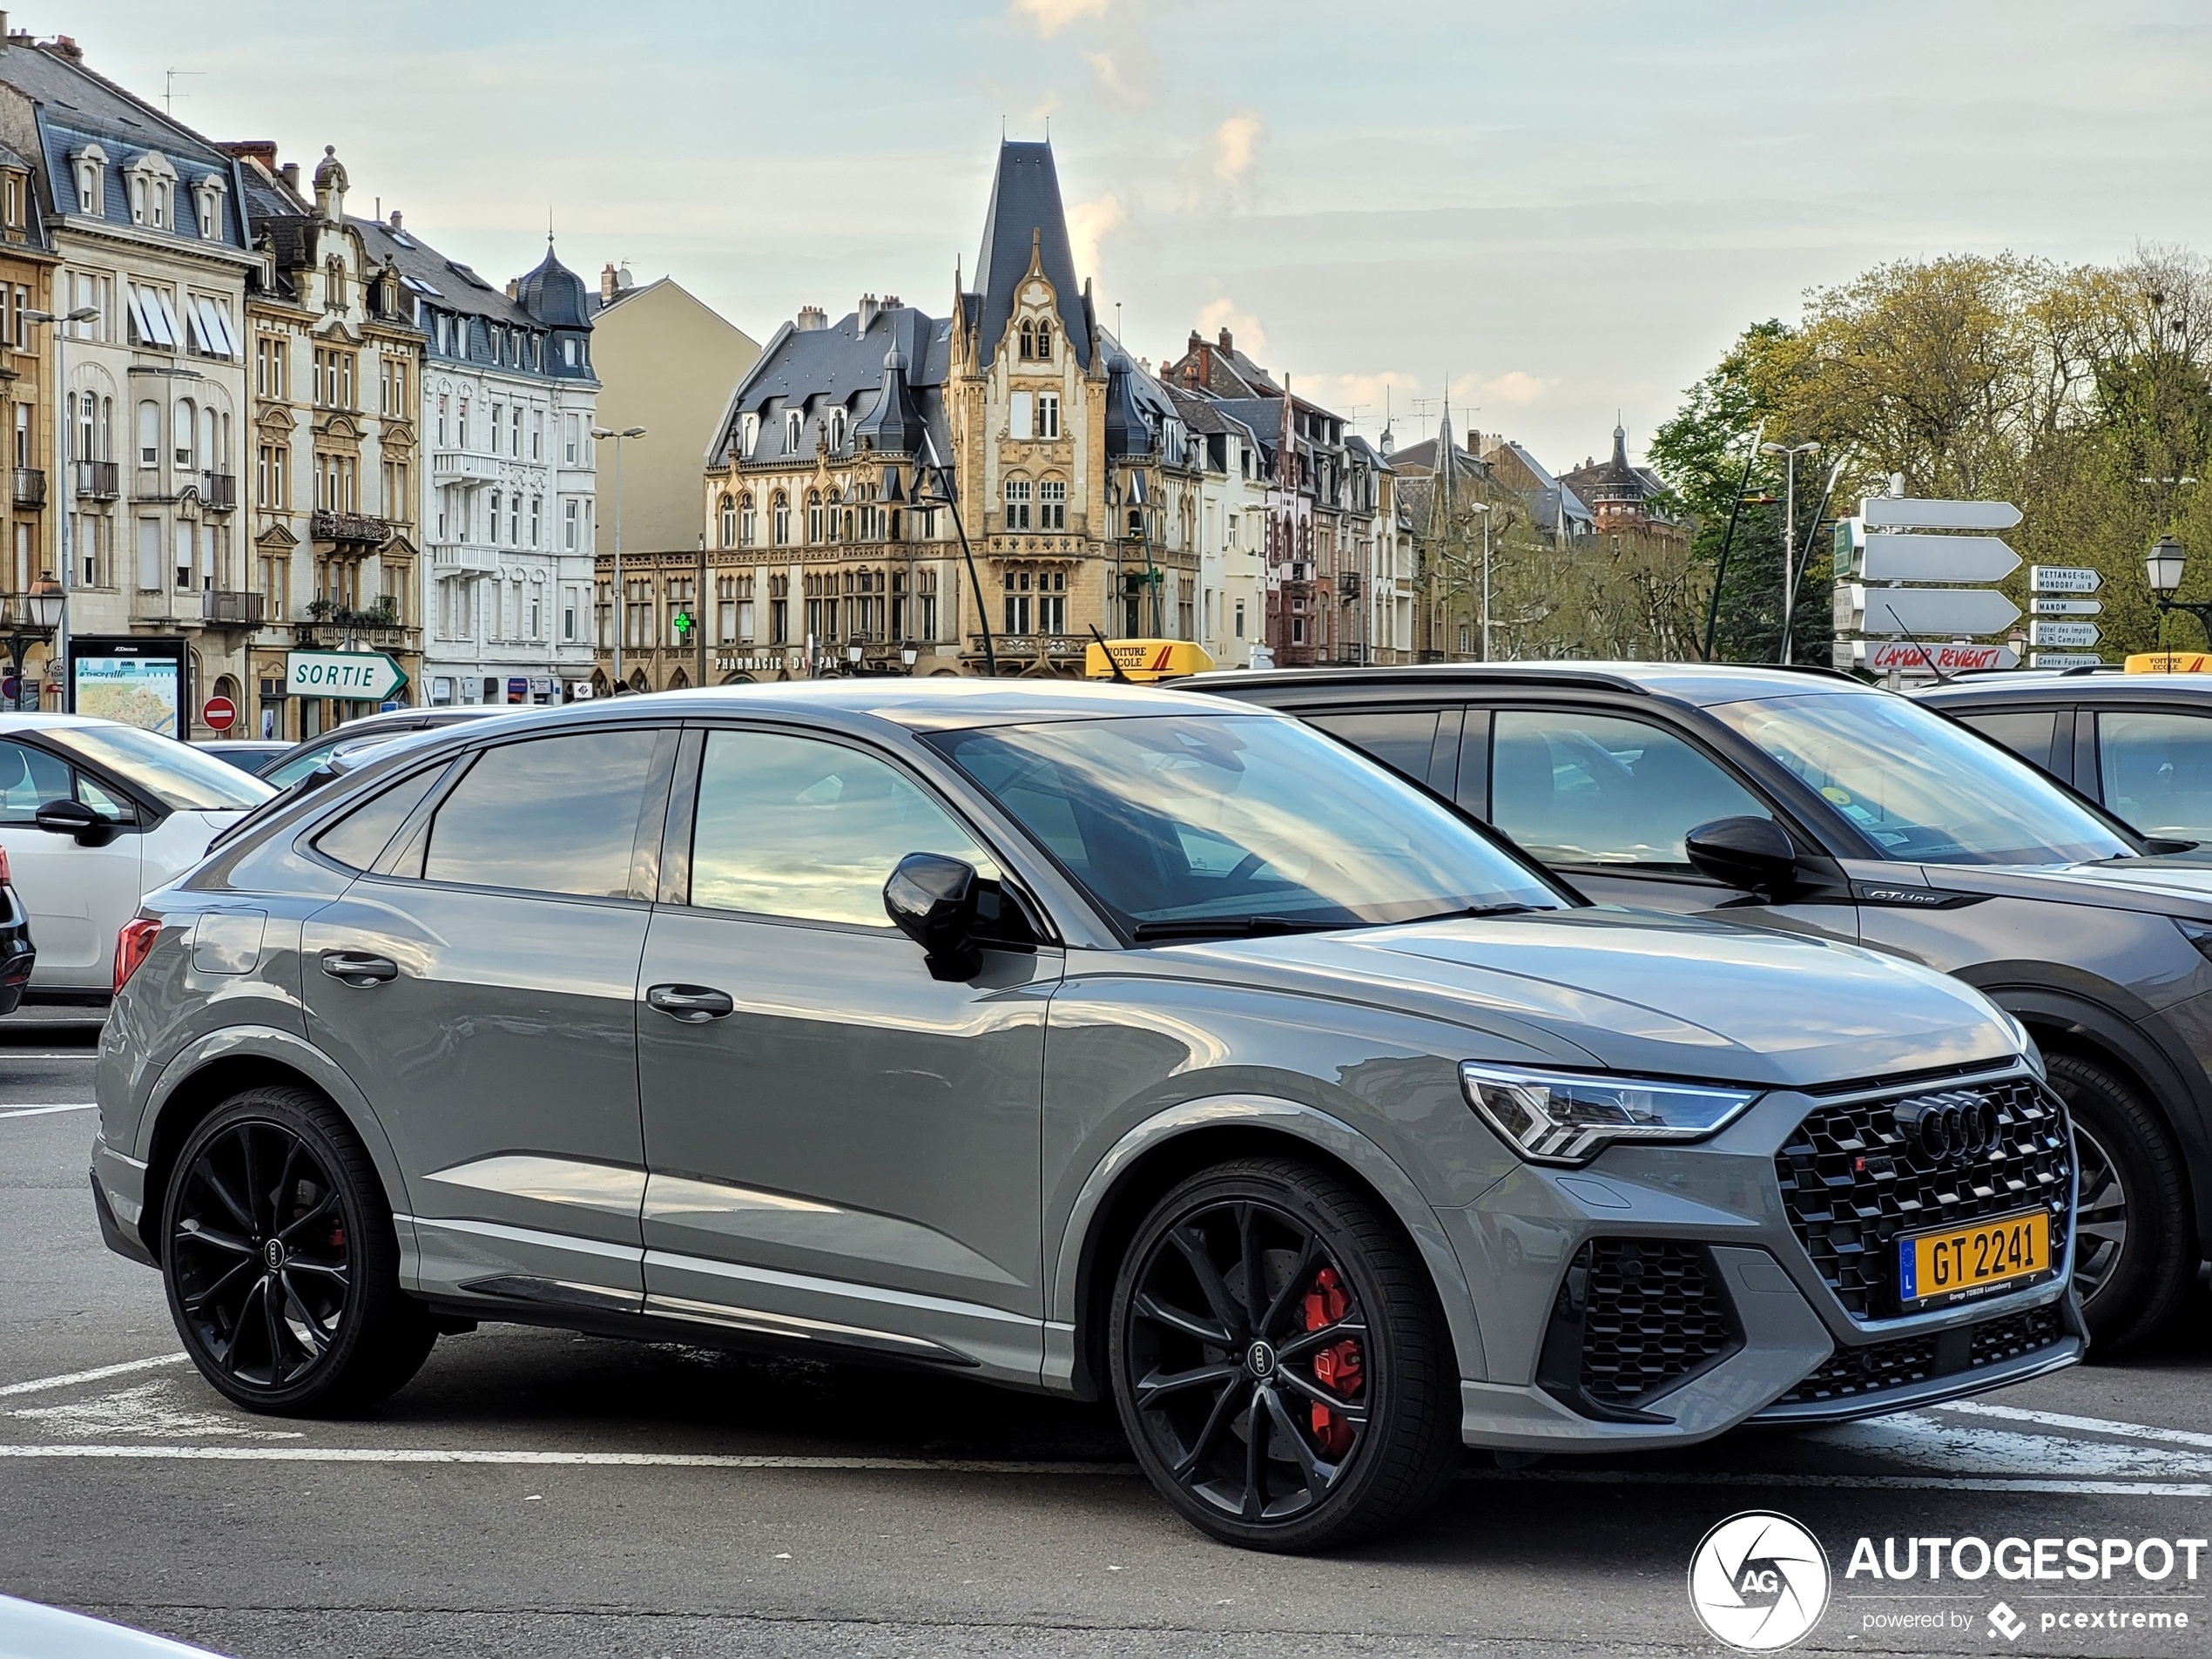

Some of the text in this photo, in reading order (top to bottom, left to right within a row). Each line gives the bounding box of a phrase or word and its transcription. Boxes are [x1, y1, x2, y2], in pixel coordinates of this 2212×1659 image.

[2039, 625, 2055, 634] Hôtel
[2072, 626, 2093, 636] Impôts
[2057, 635, 2087, 645] Camping
[714, 657, 782, 671] PHARMACIE
[1113, 658, 1143, 667] COLE
[295, 664, 374, 687] SORTIE
[247, 1101, 276, 1110] SureGrip
[276, 1104, 287, 1114] Pro
[1932, 1222, 2034, 1285] GT 2241
[1905, 1274, 1912, 1290] L
[1949, 1291, 1966, 1301] Garage
[1985, 1281, 2012, 1293] Luxembourg
